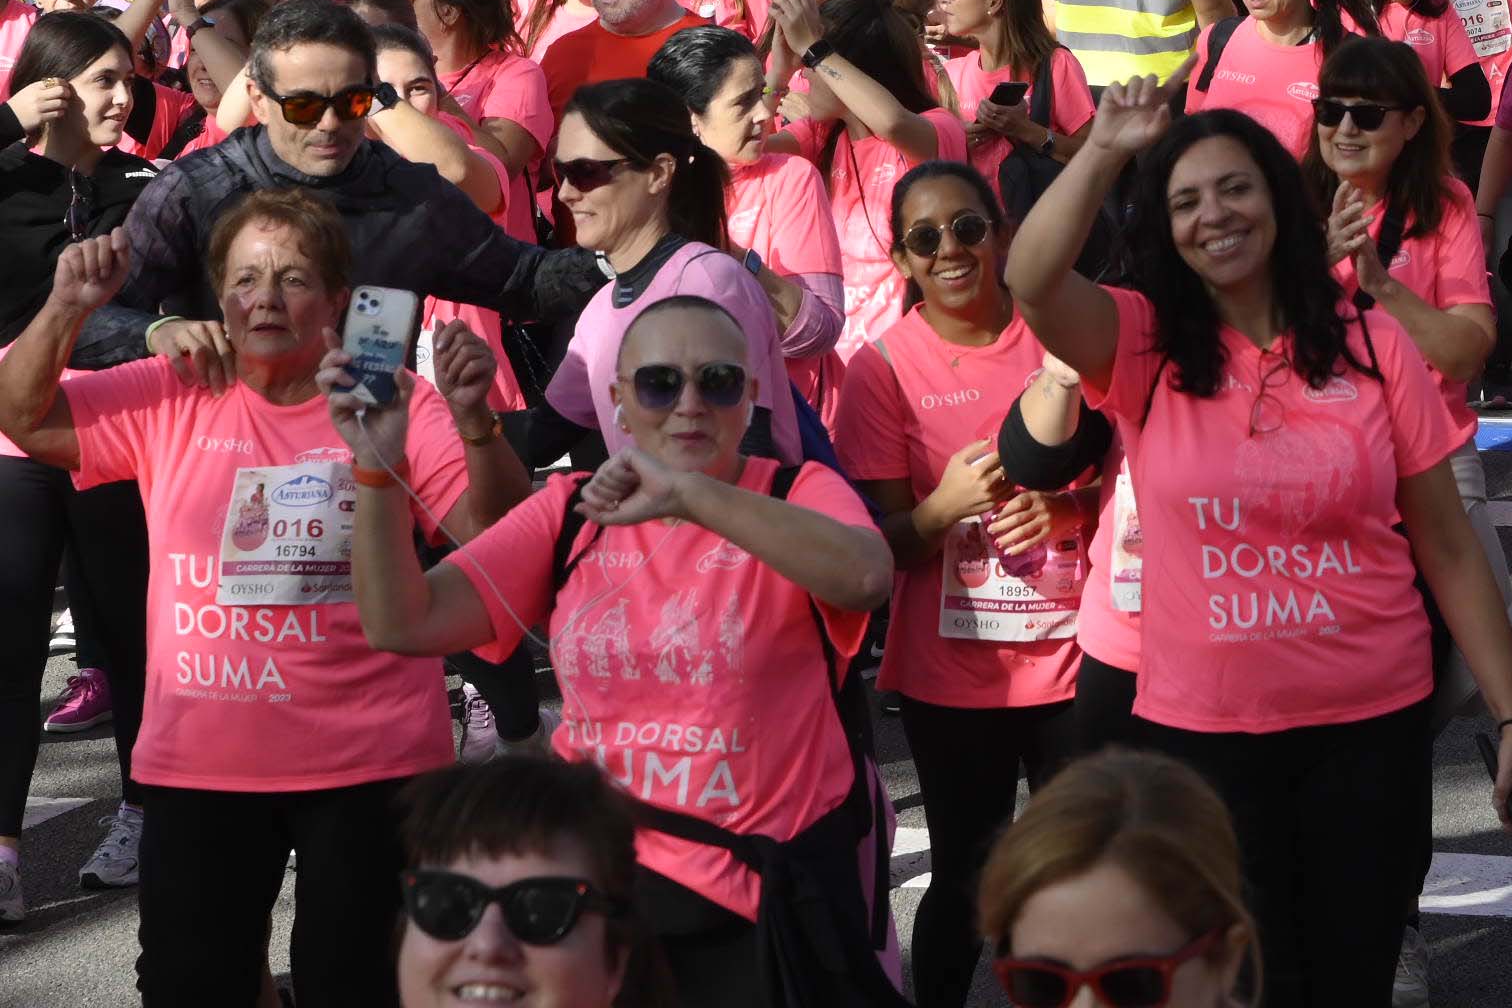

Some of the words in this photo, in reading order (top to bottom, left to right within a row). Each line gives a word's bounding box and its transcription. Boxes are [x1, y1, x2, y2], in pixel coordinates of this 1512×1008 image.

[1216, 70, 1256, 85] OYSHO
[921, 388, 980, 409] OYSHO
[197, 435, 256, 456] OYSHO
[278, 489, 329, 501] ASTURIANA
[1187, 496, 1241, 531] TU
[272, 518, 325, 539] 016
[275, 545, 317, 558] 16794
[1201, 539, 1361, 580] DORSAL
[168, 553, 214, 589] TU
[236, 563, 275, 572] CARRERA
[276, 564, 291, 572] DE
[290, 563, 304, 573] LA
[305, 564, 337, 572] MUJER
[230, 583, 275, 595] OYSHO
[999, 585, 1037, 598] 18957
[959, 600, 1000, 610] CARRERA
[1000, 602, 1013, 611] DE
[1015, 602, 1027, 611] LA
[1028, 601, 1056, 611] MUJER
[1208, 588, 1336, 630] SUMA
[174, 602, 327, 643] DORSAL
[953, 616, 1000, 631] OYSHO
[175, 650, 287, 690] SUMA
[567, 720, 602, 746] TU
[615, 722, 749, 754] DORSAL
